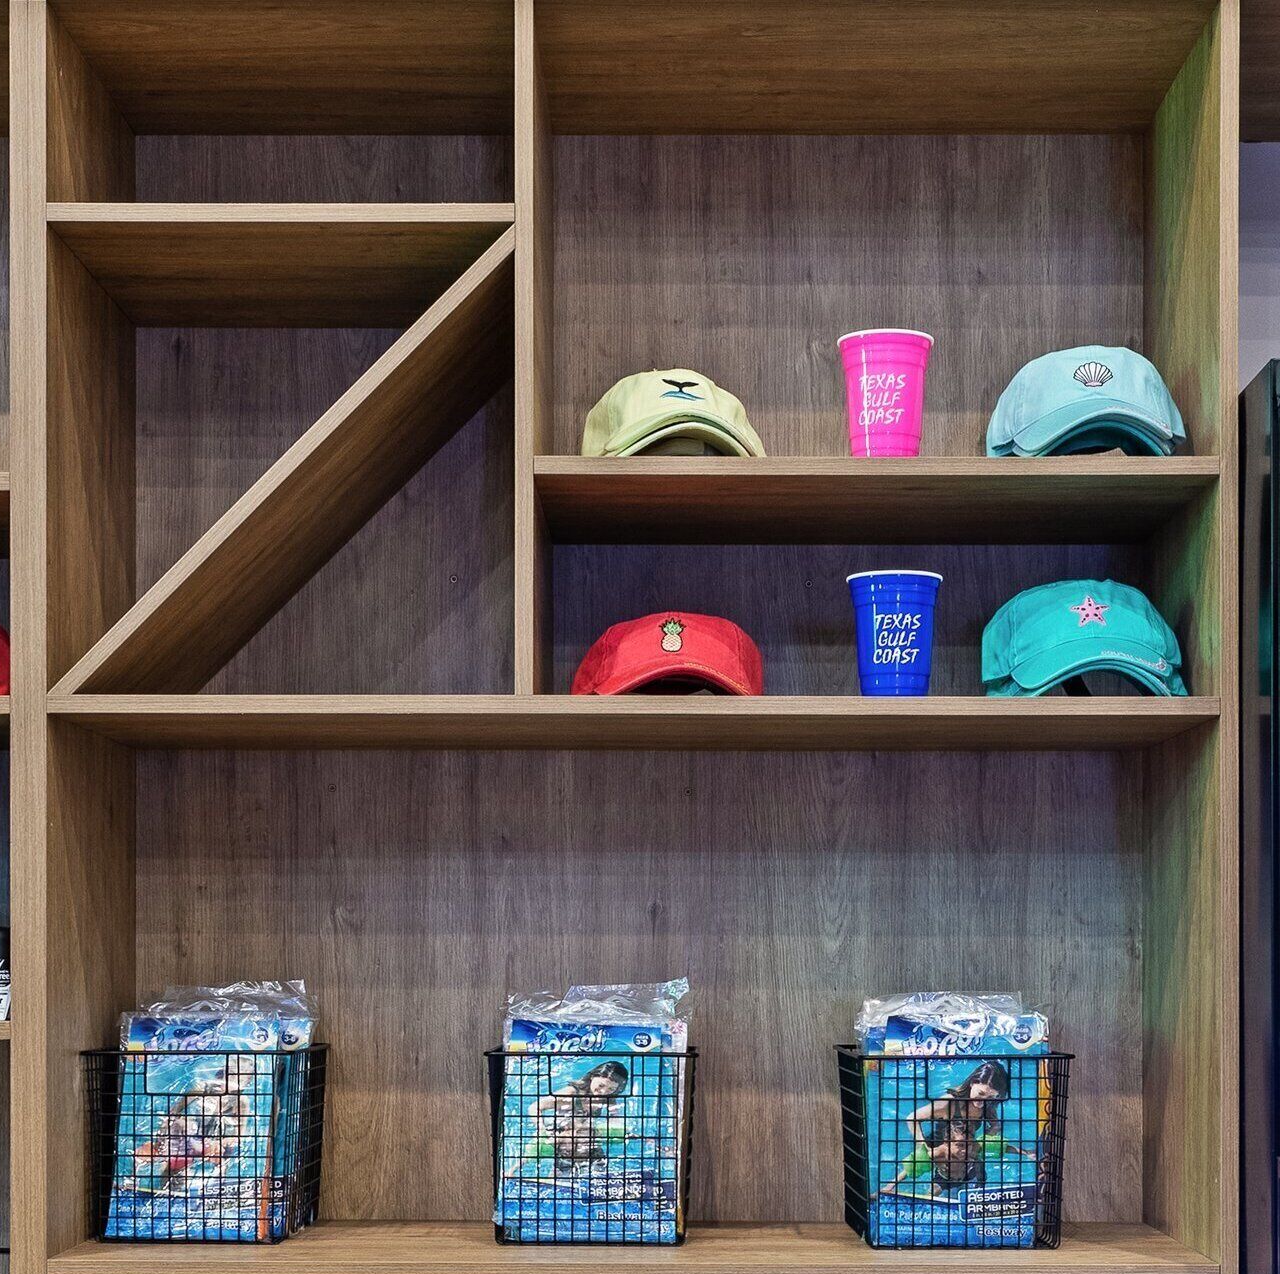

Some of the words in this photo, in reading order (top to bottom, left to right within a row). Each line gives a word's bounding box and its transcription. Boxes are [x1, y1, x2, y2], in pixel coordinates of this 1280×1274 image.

[859, 373, 907, 391] TEXAS
[862, 391, 901, 407] GULF
[858, 407, 905, 425] COAST
[873, 613, 922, 629] TEXAS
[878, 630, 917, 647] GULF
[873, 647, 920, 664] COAST
[967, 1190, 1024, 1203] ASSORTED
[976, 1225, 1028, 1238] Bestway
